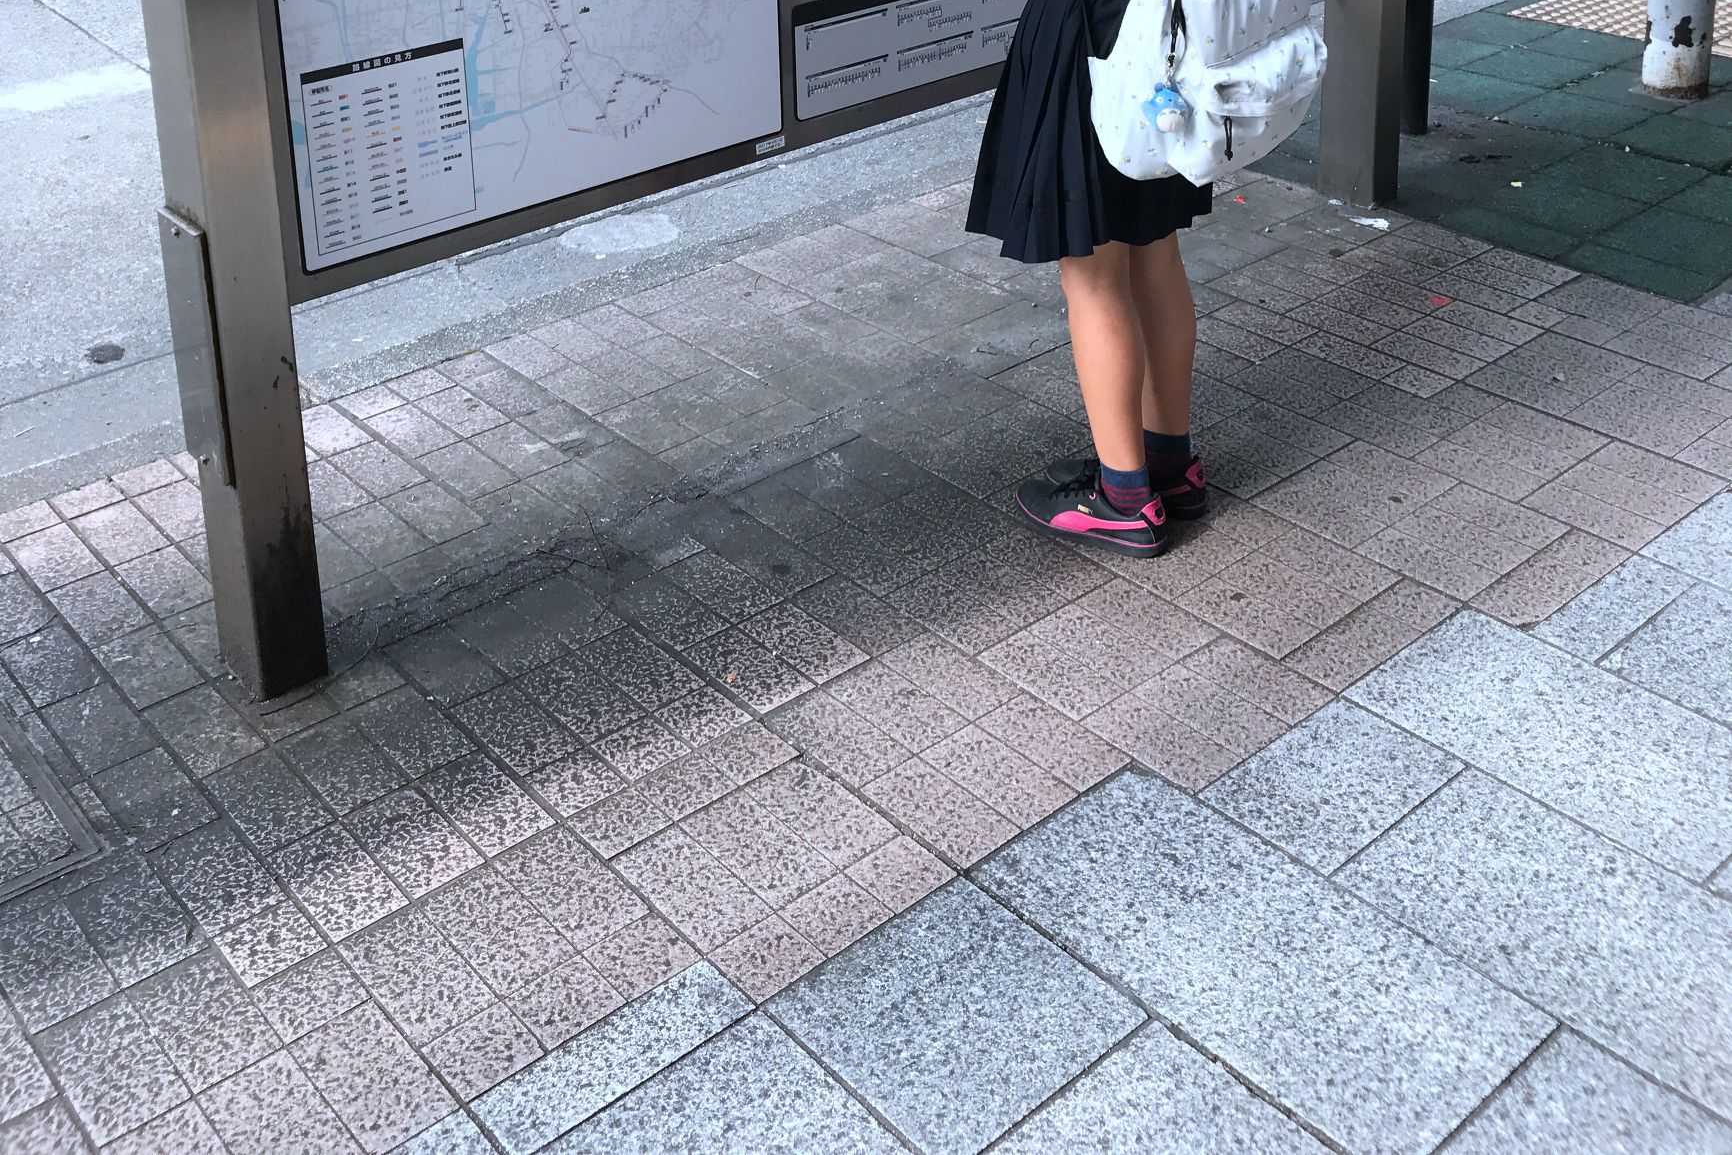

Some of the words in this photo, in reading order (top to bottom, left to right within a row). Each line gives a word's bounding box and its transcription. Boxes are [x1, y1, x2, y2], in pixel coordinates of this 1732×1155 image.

[352, 52, 412, 72] 路線図の見方
